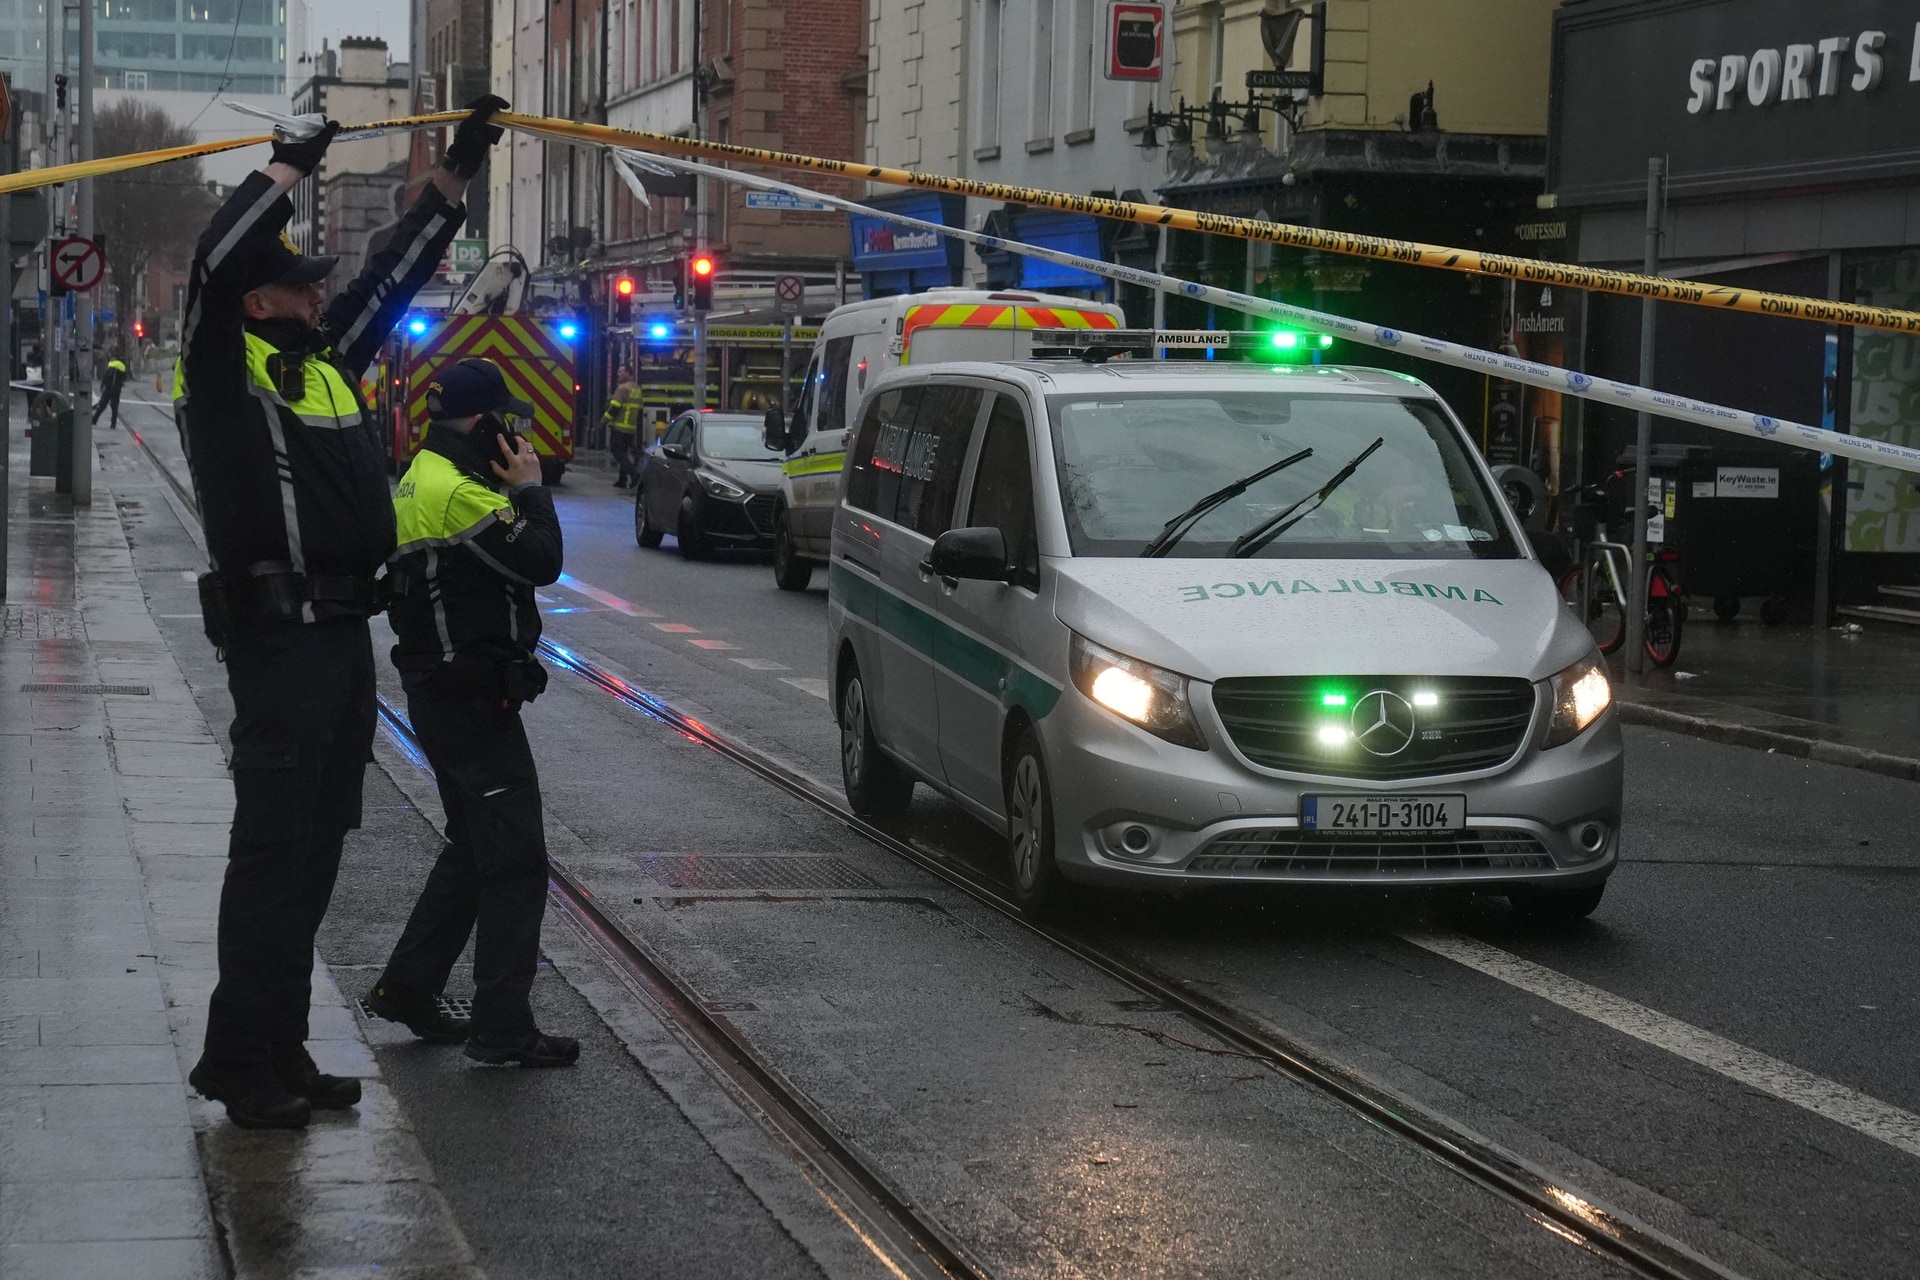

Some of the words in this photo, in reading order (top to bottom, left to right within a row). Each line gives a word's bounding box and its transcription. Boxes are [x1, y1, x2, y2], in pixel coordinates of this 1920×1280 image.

[1687, 30, 1887, 114] SPORTS
[1252, 72, 1310, 86] GUINNESS
[1196, 218, 1237, 236] THIOS
[1520, 222, 1566, 240] CONFESSION
[1346, 240, 1388, 258] CABLA
[1392, 246, 1422, 262] AIRE
[1069, 260, 1094, 271] ENTRY
[1096, 265, 1108, 274] NO
[1480, 259, 1518, 276] THIOS
[1112, 269, 1137, 280] SCENE
[1138, 276, 1162, 286] CRIME
[1626, 280, 1669, 298] CABLA
[1674, 286, 1704, 302] AIRE
[1268, 306, 1294, 318] ENTRY
[1760, 298, 1799, 316] THIOS
[1294, 312, 1306, 320] NO
[1310, 315, 1334, 327] SCENE
[1335, 321, 1358, 332] CRIME
[1157, 334, 1228, 344] AMBULANCE
[1462, 351, 1486, 363] ENTRY
[1488, 357, 1498, 365] NO
[1502, 360, 1526, 372] SCENE
[1527, 366, 1550, 376] CRIME
[1652, 395, 1675, 406] ENTRY
[1676, 400, 1688, 409] NO
[1692, 404, 1715, 414] SCENE
[1716, 408, 1738, 420] CRIME
[1839, 437, 1861, 448] ENTRY
[1861, 442, 1872, 450] NO
[1877, 444, 1900, 456] SCENE
[1719, 474, 1777, 485] KeyWaste.ie
[1303, 816, 1316, 824] IRL
[1332, 802, 1448, 828] 241-D-3104
